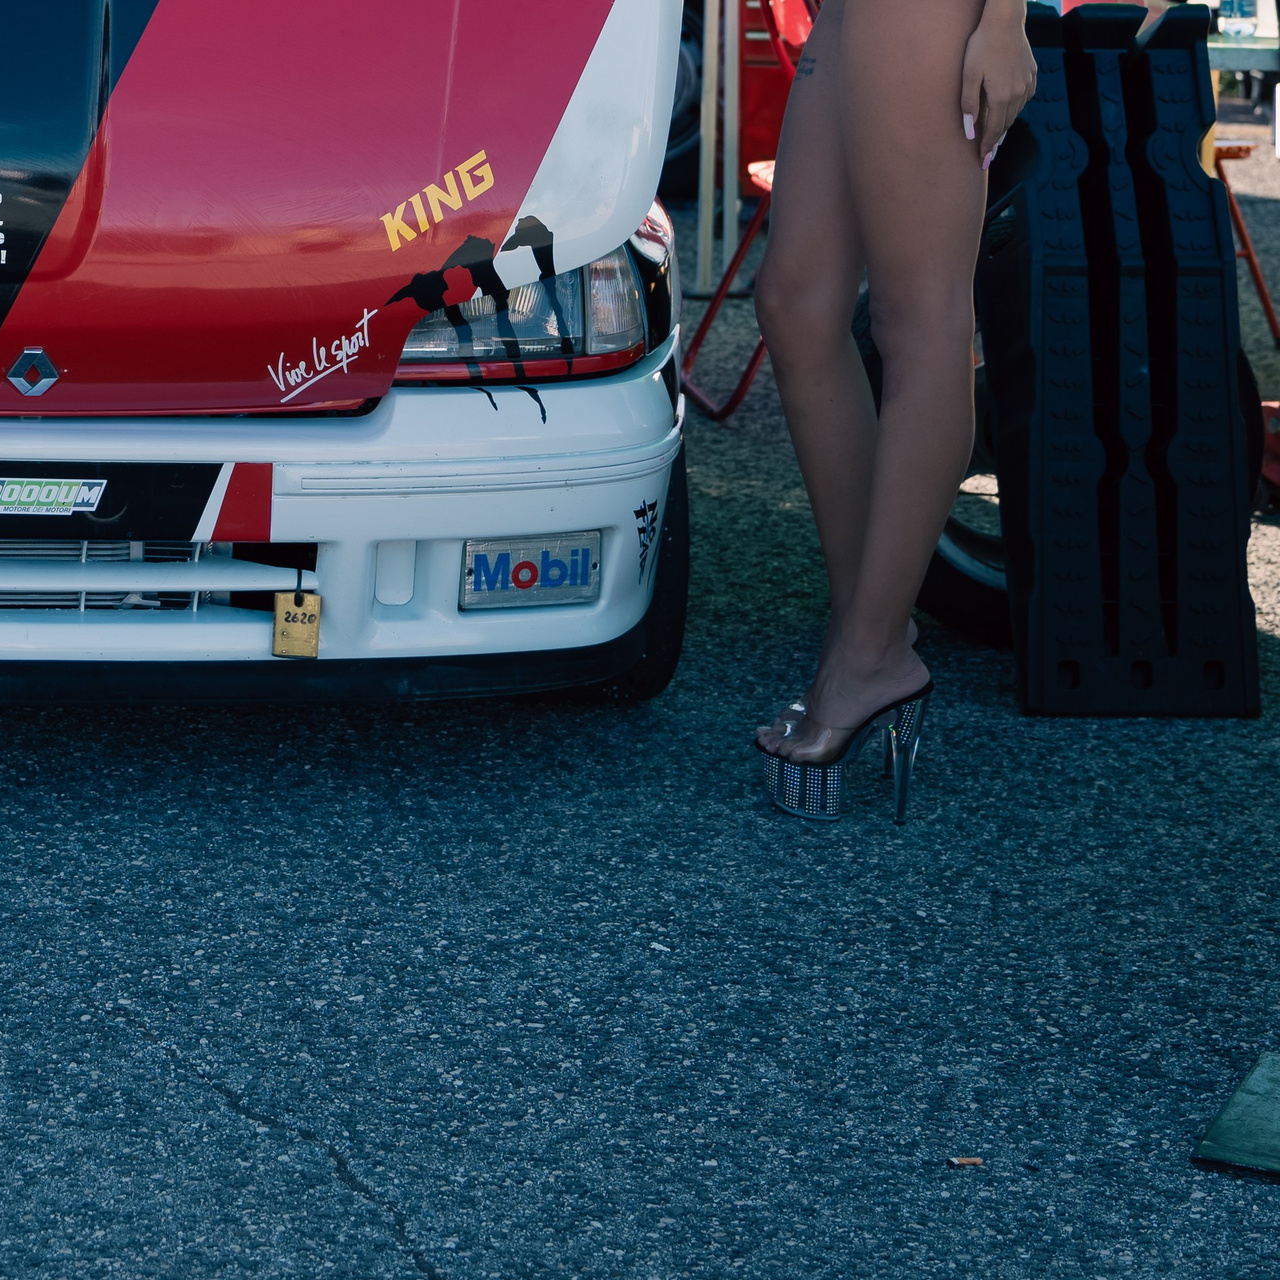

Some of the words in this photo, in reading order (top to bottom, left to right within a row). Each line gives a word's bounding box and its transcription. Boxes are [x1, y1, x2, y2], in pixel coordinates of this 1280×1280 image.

[379, 149, 495, 252] KING
[267, 352, 314, 392] Vive
[312, 337, 331, 371] le
[331, 308, 378, 374] sport
[473, 548, 590, 592] Mobil
[284, 610, 317, 625] 2620
